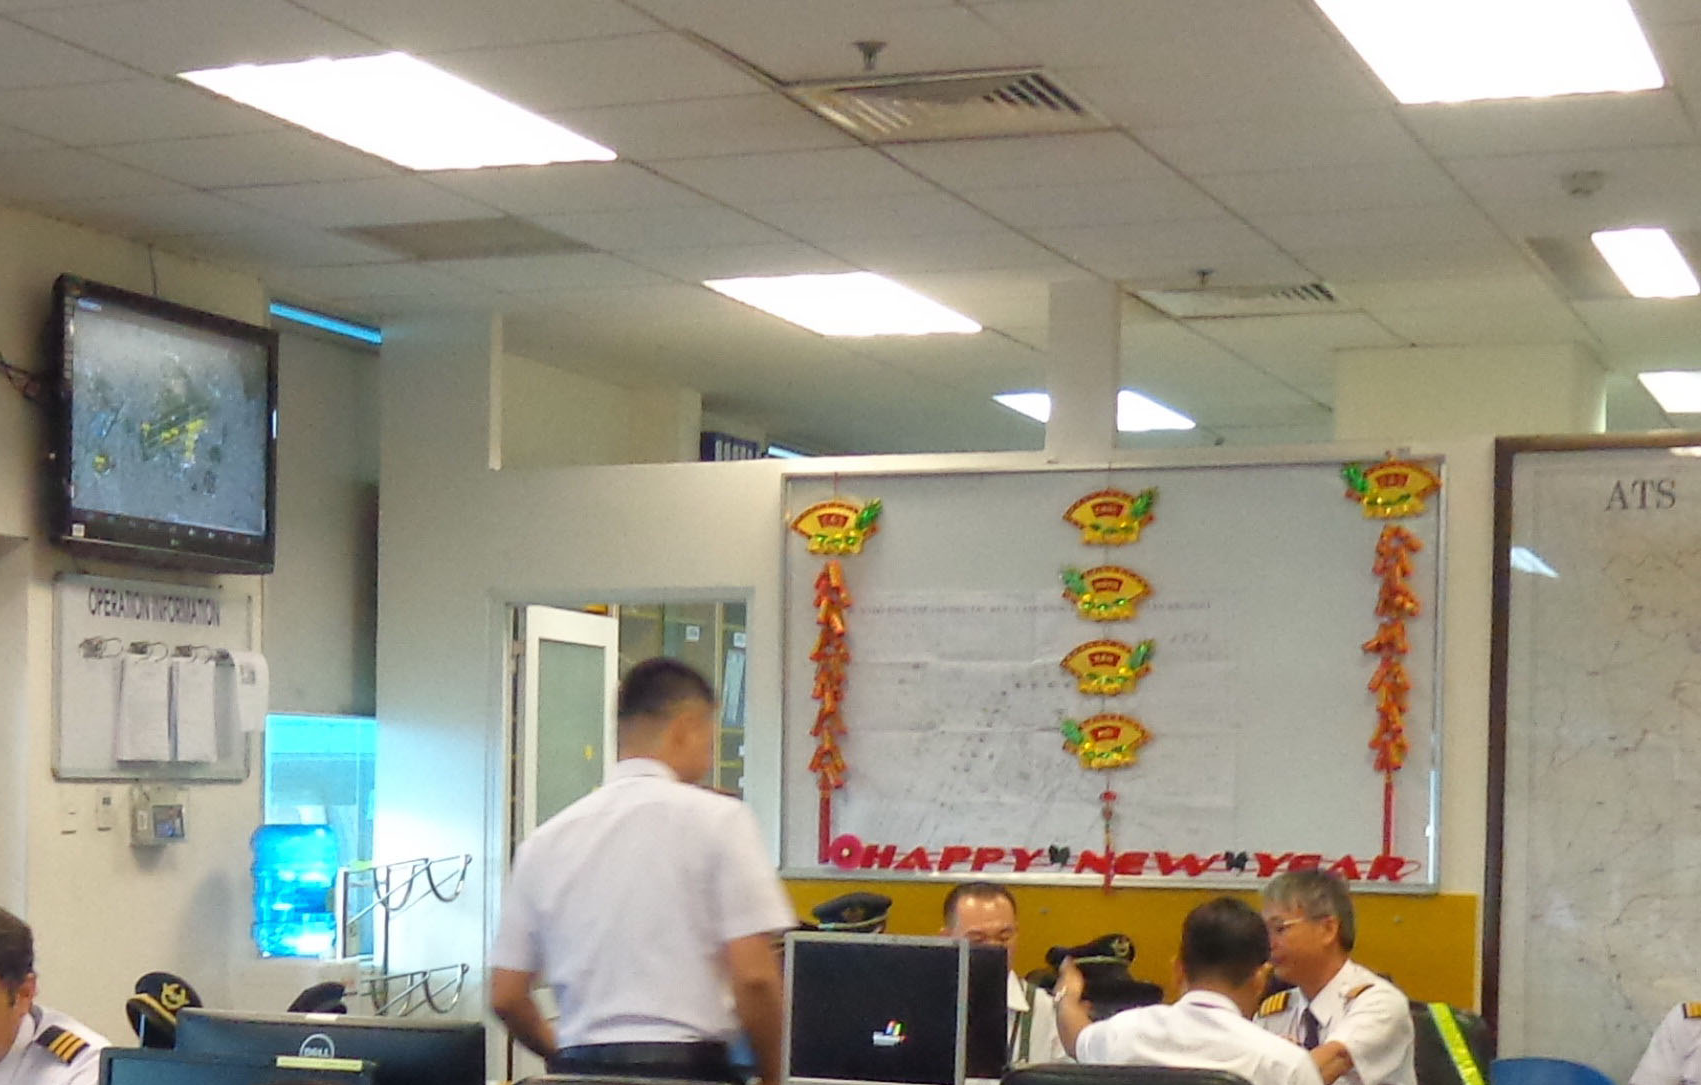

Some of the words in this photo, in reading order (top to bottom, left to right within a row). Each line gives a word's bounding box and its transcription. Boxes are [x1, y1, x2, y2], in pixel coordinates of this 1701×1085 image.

[1604, 479, 1676, 512] ATS
[89, 587, 148, 620] OPERATION
[150, 594, 220, 626] INFORMATION
[860, 844, 1043, 872] HAPPY
[1075, 850, 1222, 876] NEW
[1255, 852, 1406, 881] YEAR
